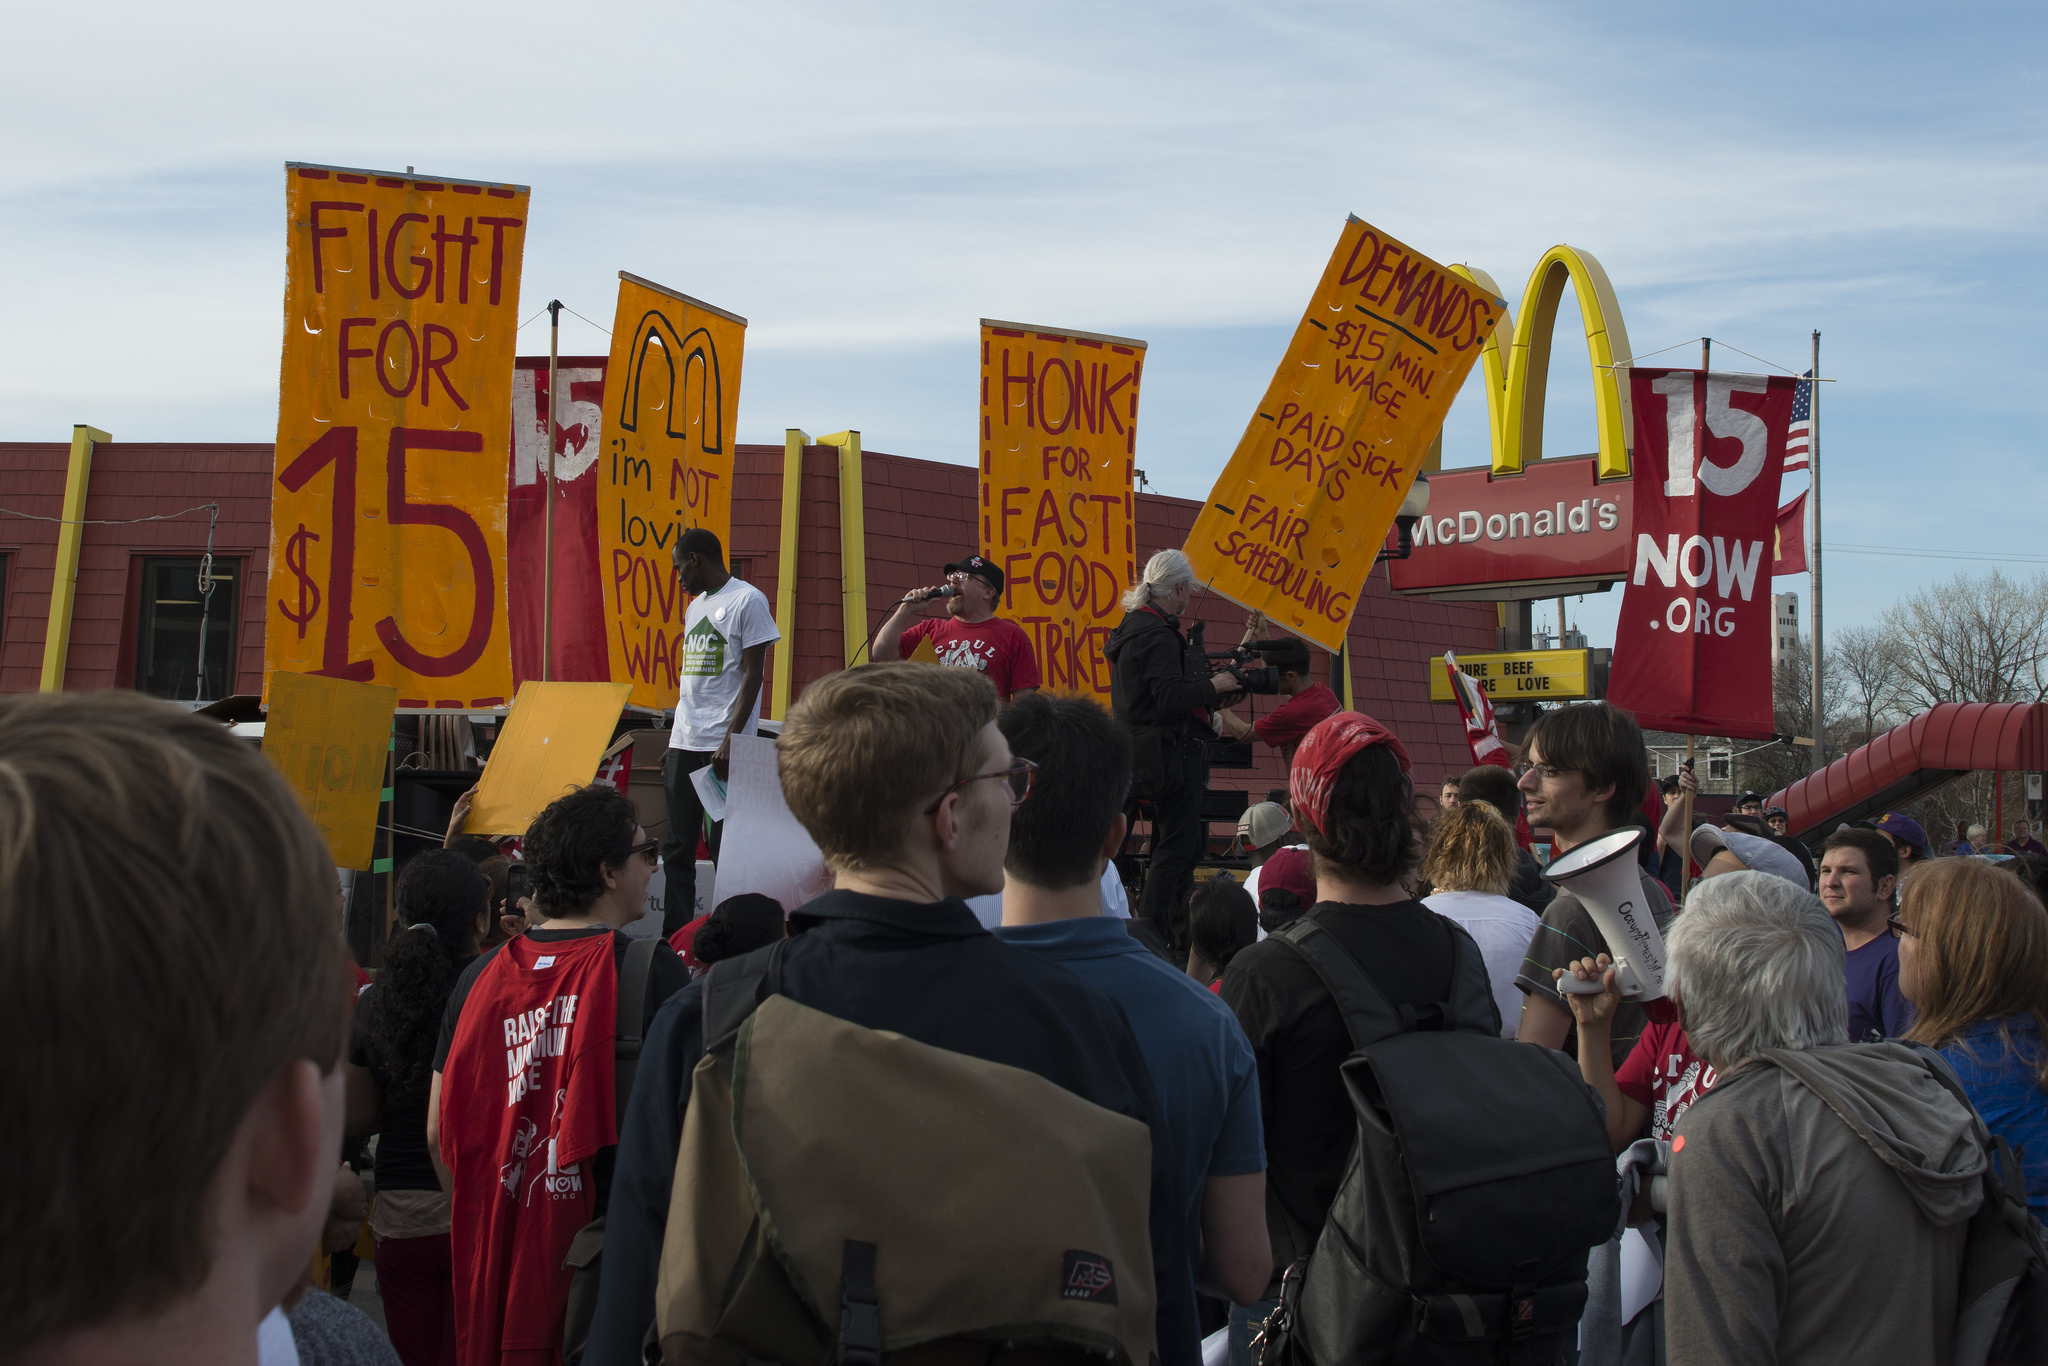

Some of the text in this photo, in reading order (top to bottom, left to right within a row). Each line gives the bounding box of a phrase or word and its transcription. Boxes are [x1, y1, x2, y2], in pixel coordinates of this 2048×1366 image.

[310, 201, 524, 306] FIGHT
[1339, 230, 1494, 352] DEMANDS:
[338, 316, 470, 411] FOR
[1328, 320, 1388, 363] $15
[1002, 348, 1134, 436] HONK
[1334, 358, 1407, 420] WAGE
[1043, 445, 1092, 482] FOR
[1652, 370, 1768, 497] 15
[669, 458, 720, 518] NOT
[1269, 437, 1351, 502] DAYS
[1001, 486, 1122, 555] FAST
[1412, 497, 1619, 549] McDonald's
[1004, 551, 1119, 620] FOOD
[1632, 533, 1764, 602] NOW
[687, 633, 719, 653] NOC
[1649, 597, 1736, 637] .ORG
[1504, 661, 1534, 676] BEEF
[1517, 676, 1550, 691] LOVE
[552, 994, 579, 1025] THE
[545, 1176, 583, 1193] NOW
